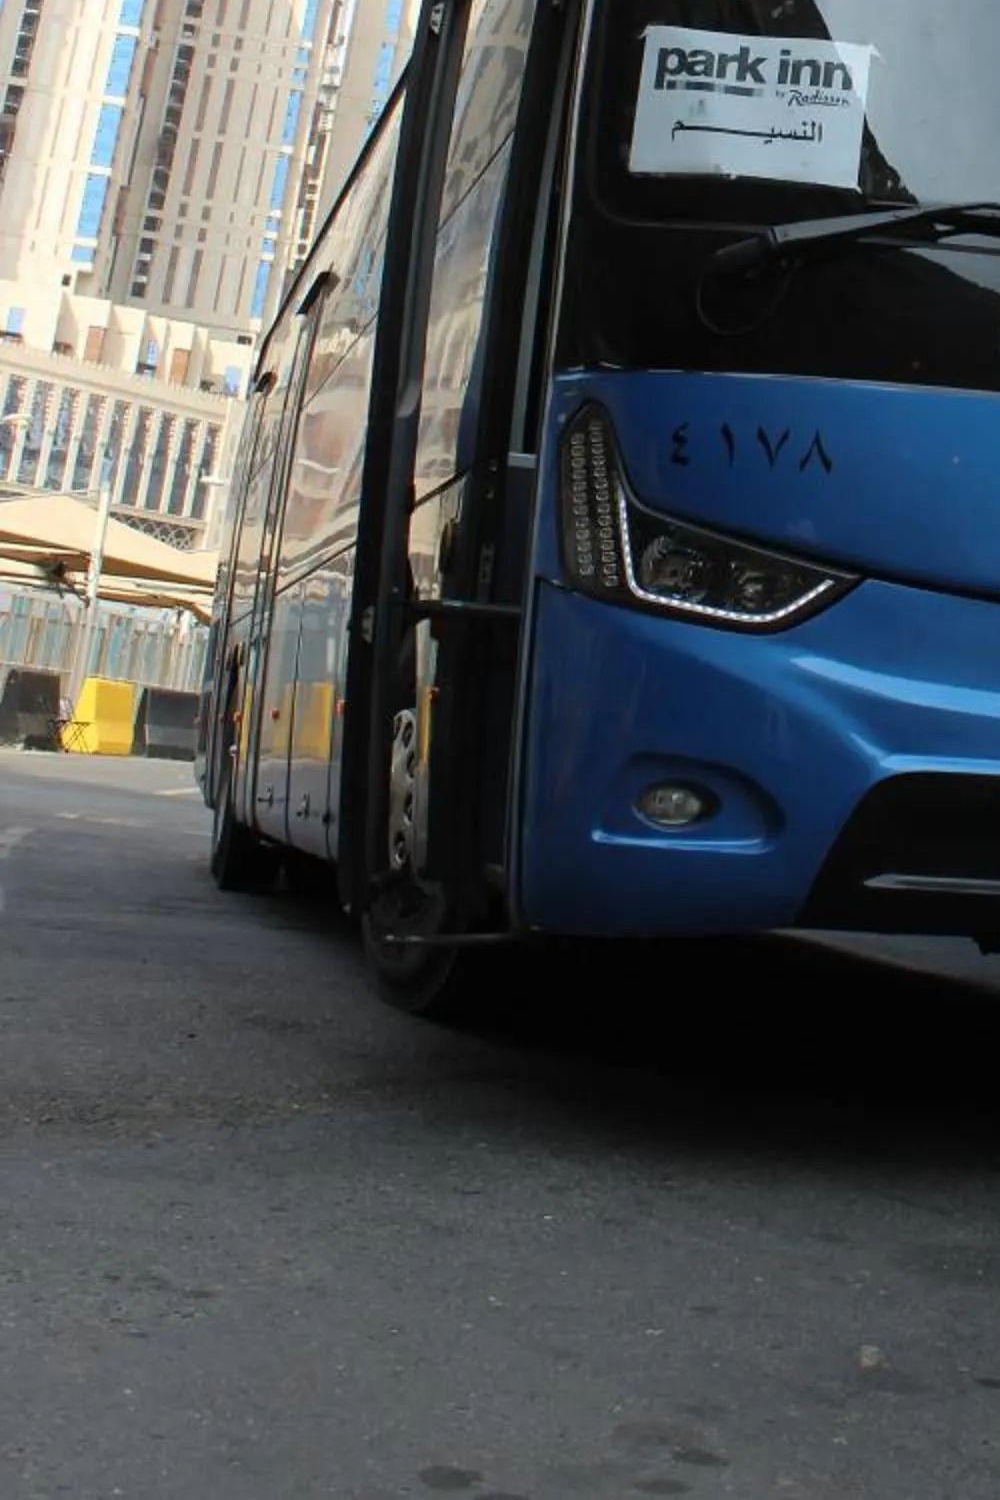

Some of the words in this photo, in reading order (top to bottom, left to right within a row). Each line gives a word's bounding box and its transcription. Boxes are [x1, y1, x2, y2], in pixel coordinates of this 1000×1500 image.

[653, 43, 768, 91] park
[777, 50, 852, 91] inn
[670, 421, 833, 475] ٤١٧٨
